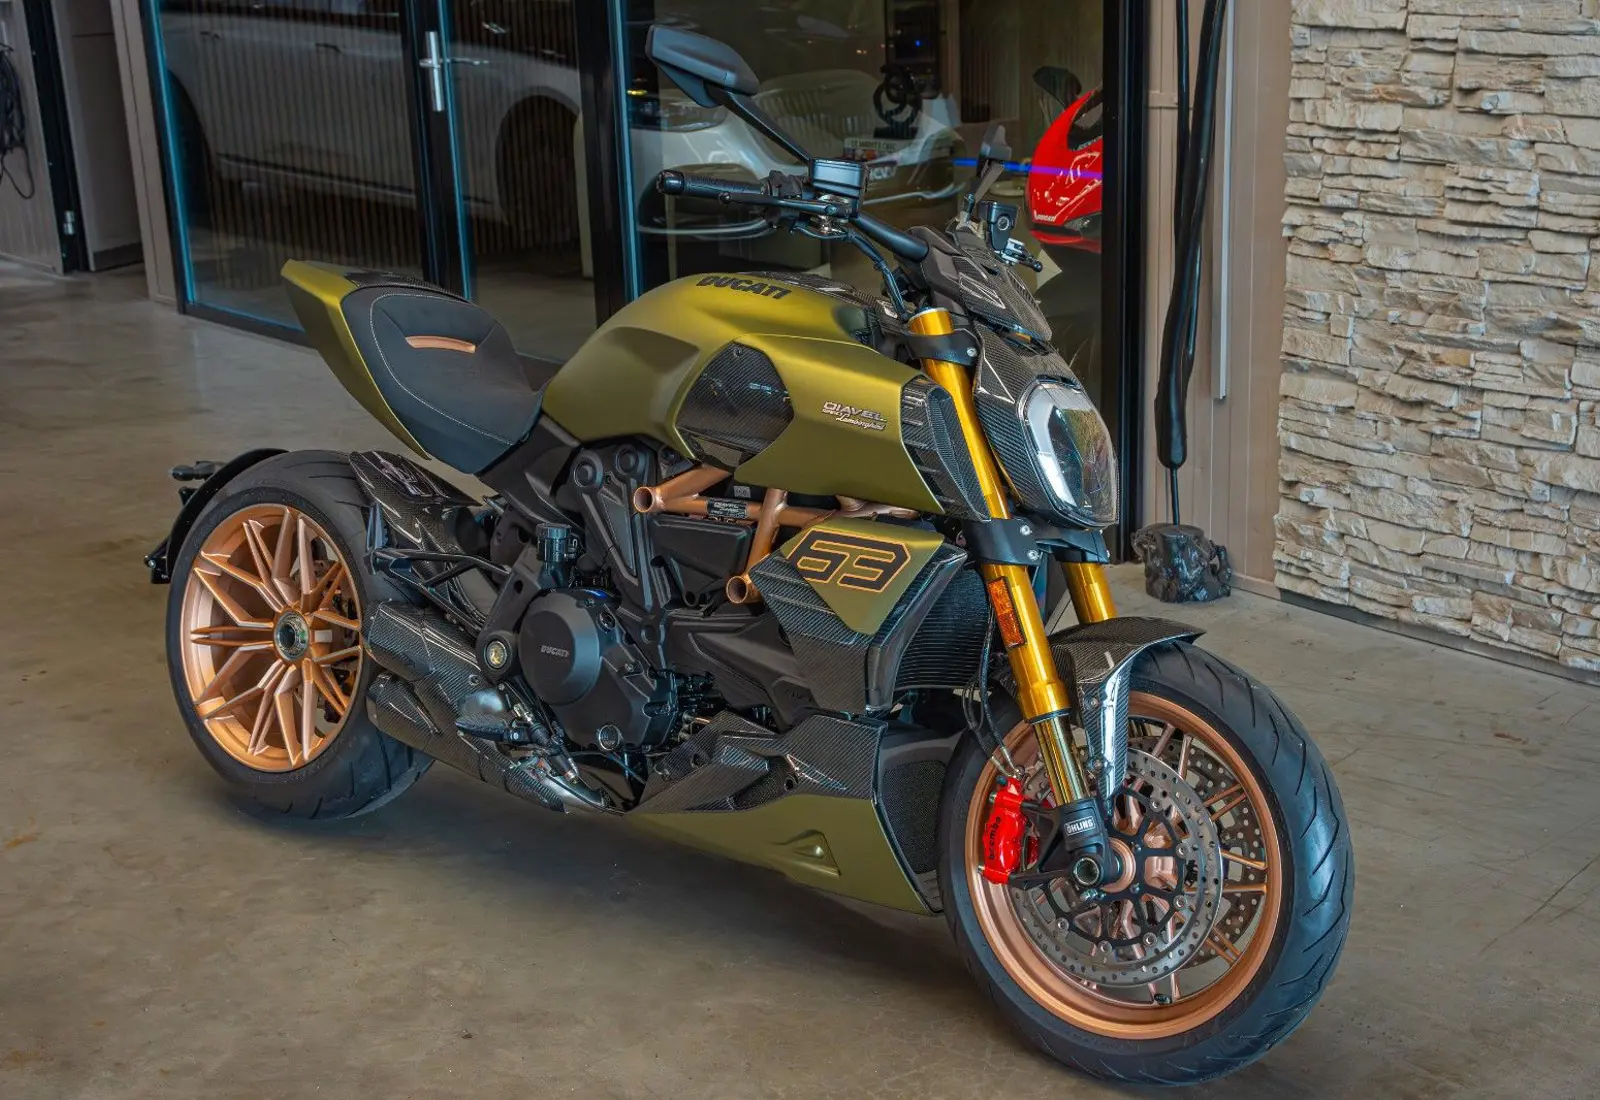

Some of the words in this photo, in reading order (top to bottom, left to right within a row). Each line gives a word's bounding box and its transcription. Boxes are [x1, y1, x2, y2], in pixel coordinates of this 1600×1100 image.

[696, 276, 792, 299] DUCATI
[823, 401, 887, 422] DIAVEL
[835, 413, 886, 431] Lamborghini
[787, 528, 911, 593] 63
[540, 644, 570, 658] DUCATI
[988, 816, 1002, 860] brembo
